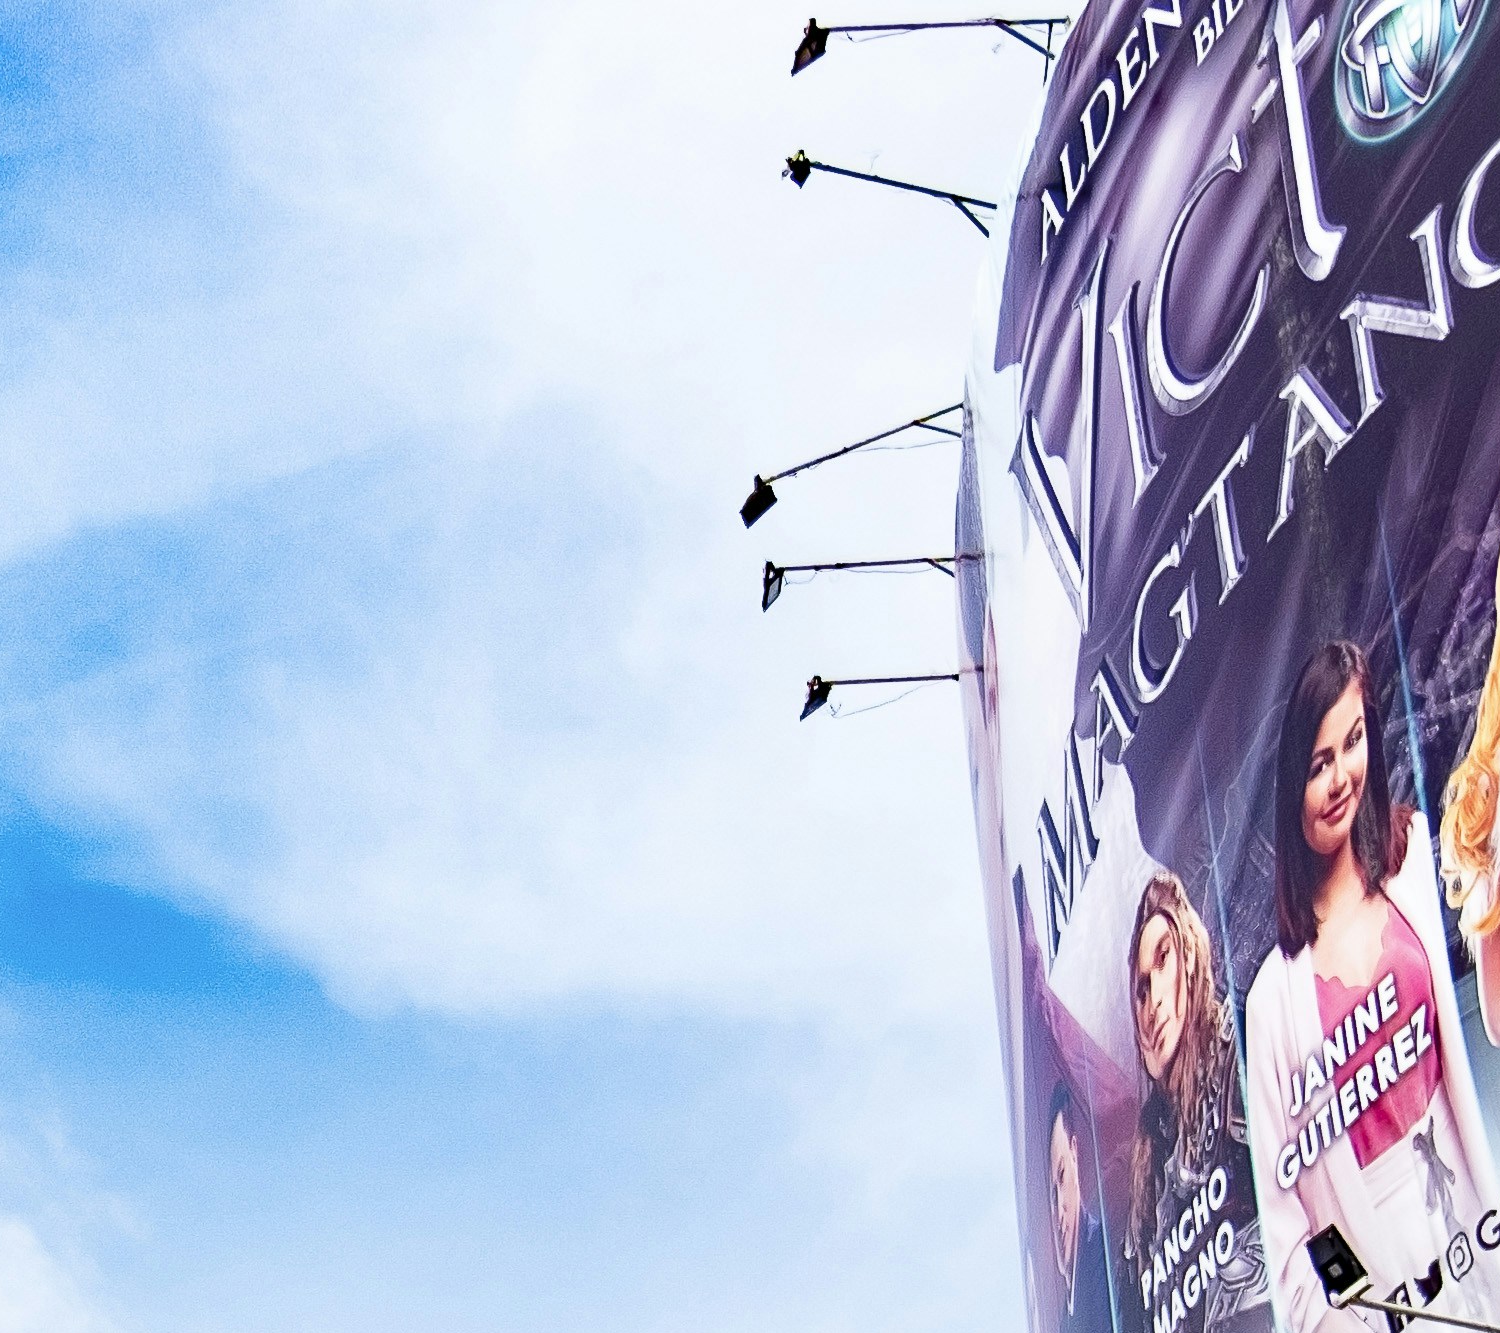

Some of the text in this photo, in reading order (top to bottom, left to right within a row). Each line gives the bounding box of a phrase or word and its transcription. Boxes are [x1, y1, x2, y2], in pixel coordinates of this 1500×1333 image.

[1276, 1008, 1433, 1190] GUTIERREZ
[1287, 973, 1400, 1118] JANINE
[1140, 1166, 1229, 1307] PANCHO
